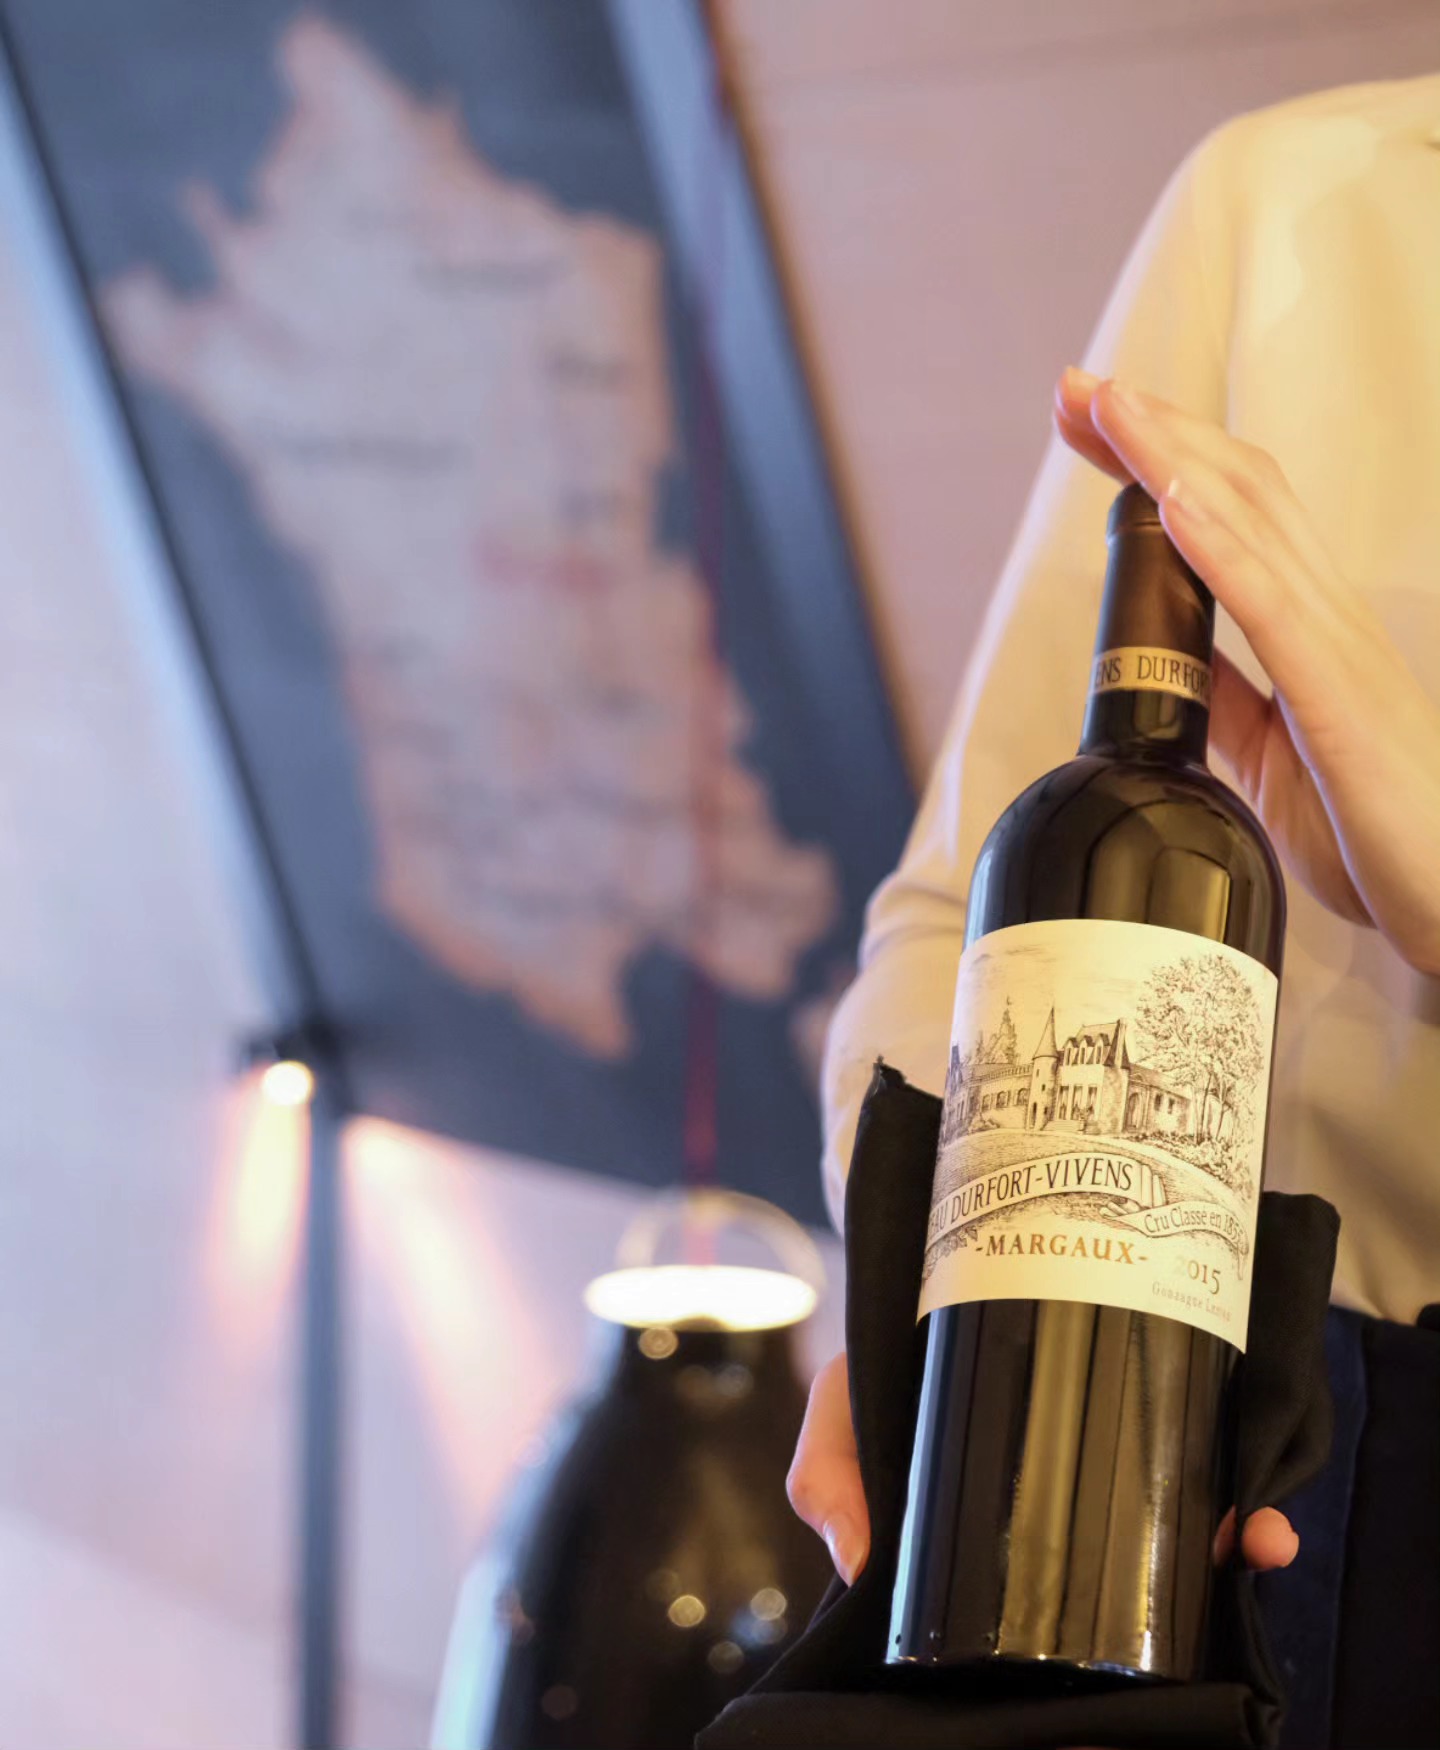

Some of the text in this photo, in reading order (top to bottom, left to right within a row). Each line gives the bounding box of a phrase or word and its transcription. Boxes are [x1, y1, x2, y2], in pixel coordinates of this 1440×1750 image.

[951, 1157, 1132, 1225] DURFORT-VIVENS
[1144, 1213, 1170, 1233] Cru
[1209, 1211, 1222, 1230] en
